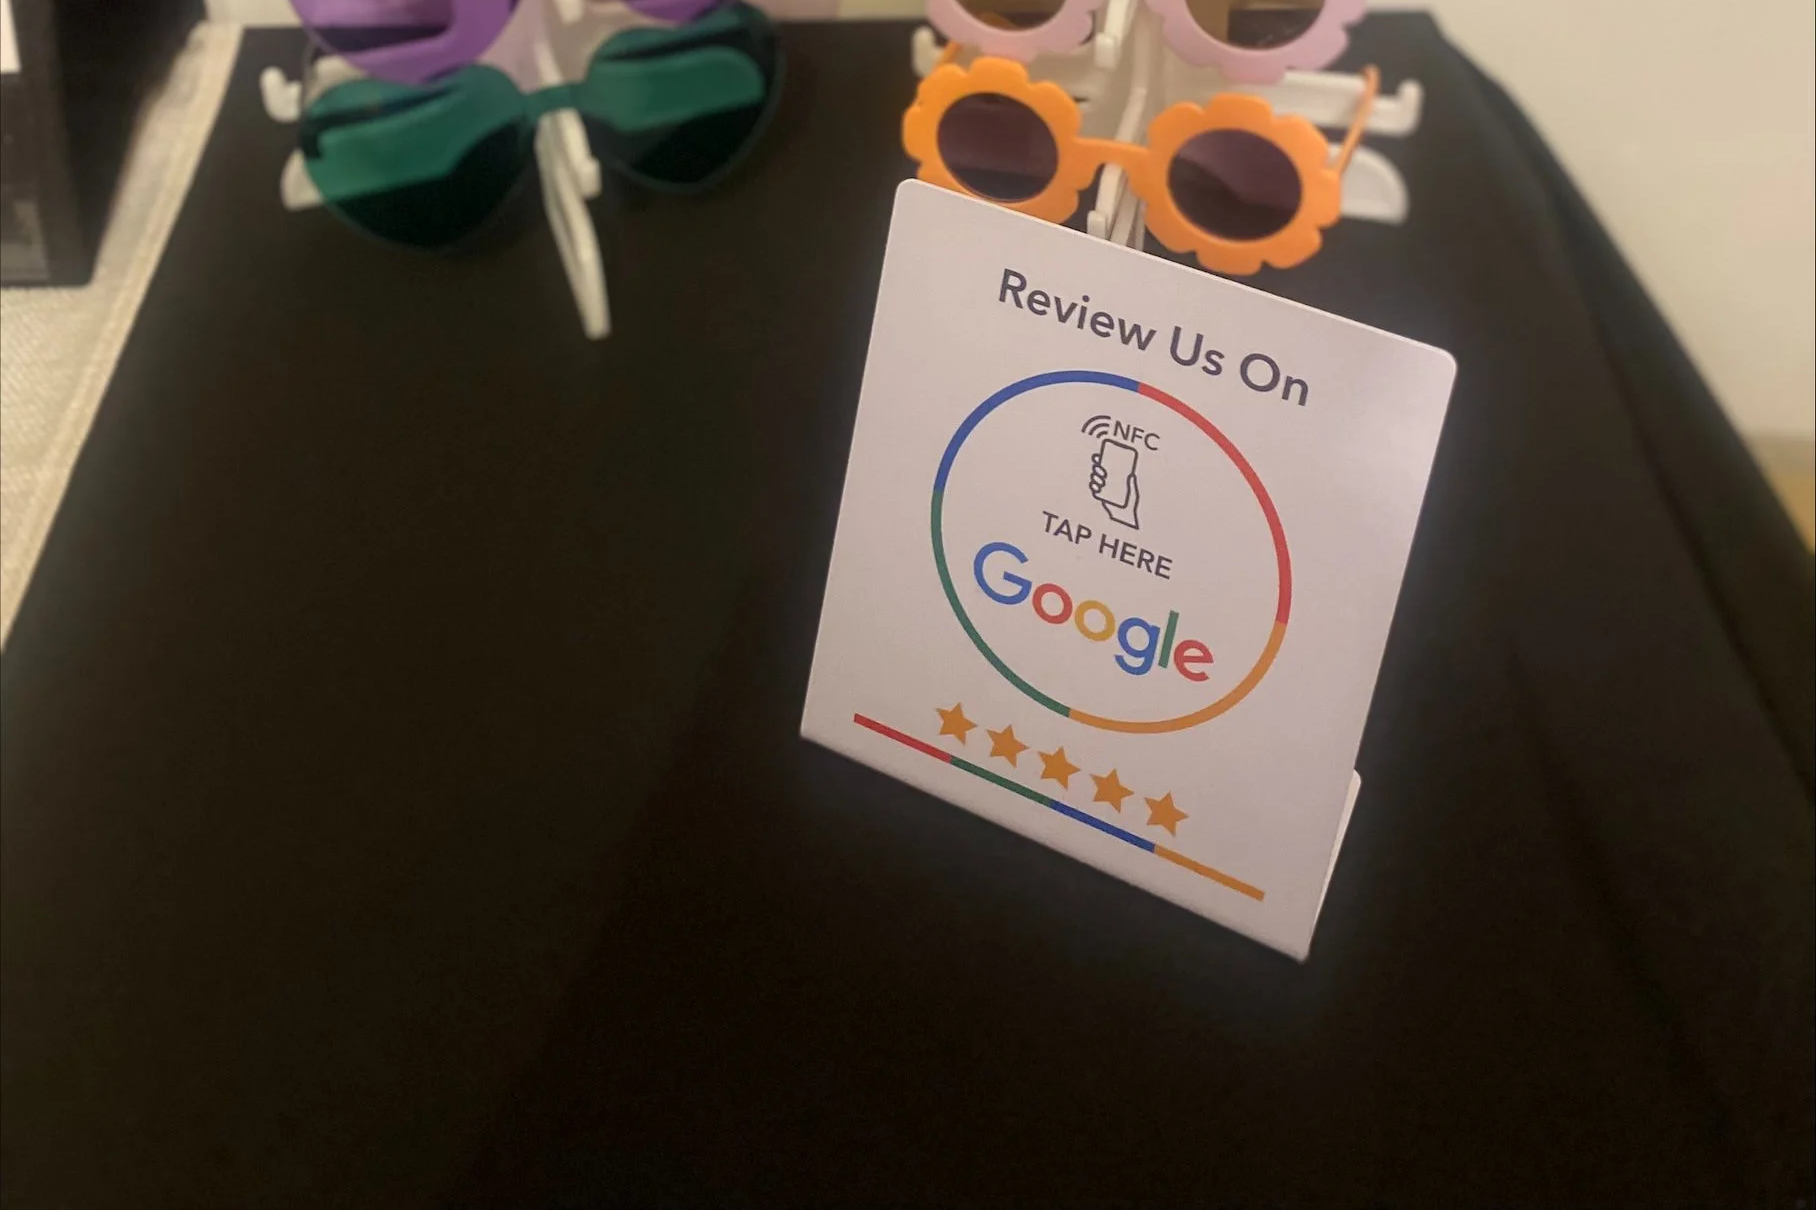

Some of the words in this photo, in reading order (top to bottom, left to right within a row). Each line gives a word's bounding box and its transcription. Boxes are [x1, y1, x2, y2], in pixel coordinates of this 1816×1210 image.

[998, 268, 1157, 351] Review
[1170, 325, 1225, 376] Us
[1240, 353, 1309, 406] On
[1113, 420, 1161, 451] NFC
[1042, 510, 1092, 545] TAP
[1098, 533, 1173, 580] HERE
[973, 542, 1214, 682] Google
